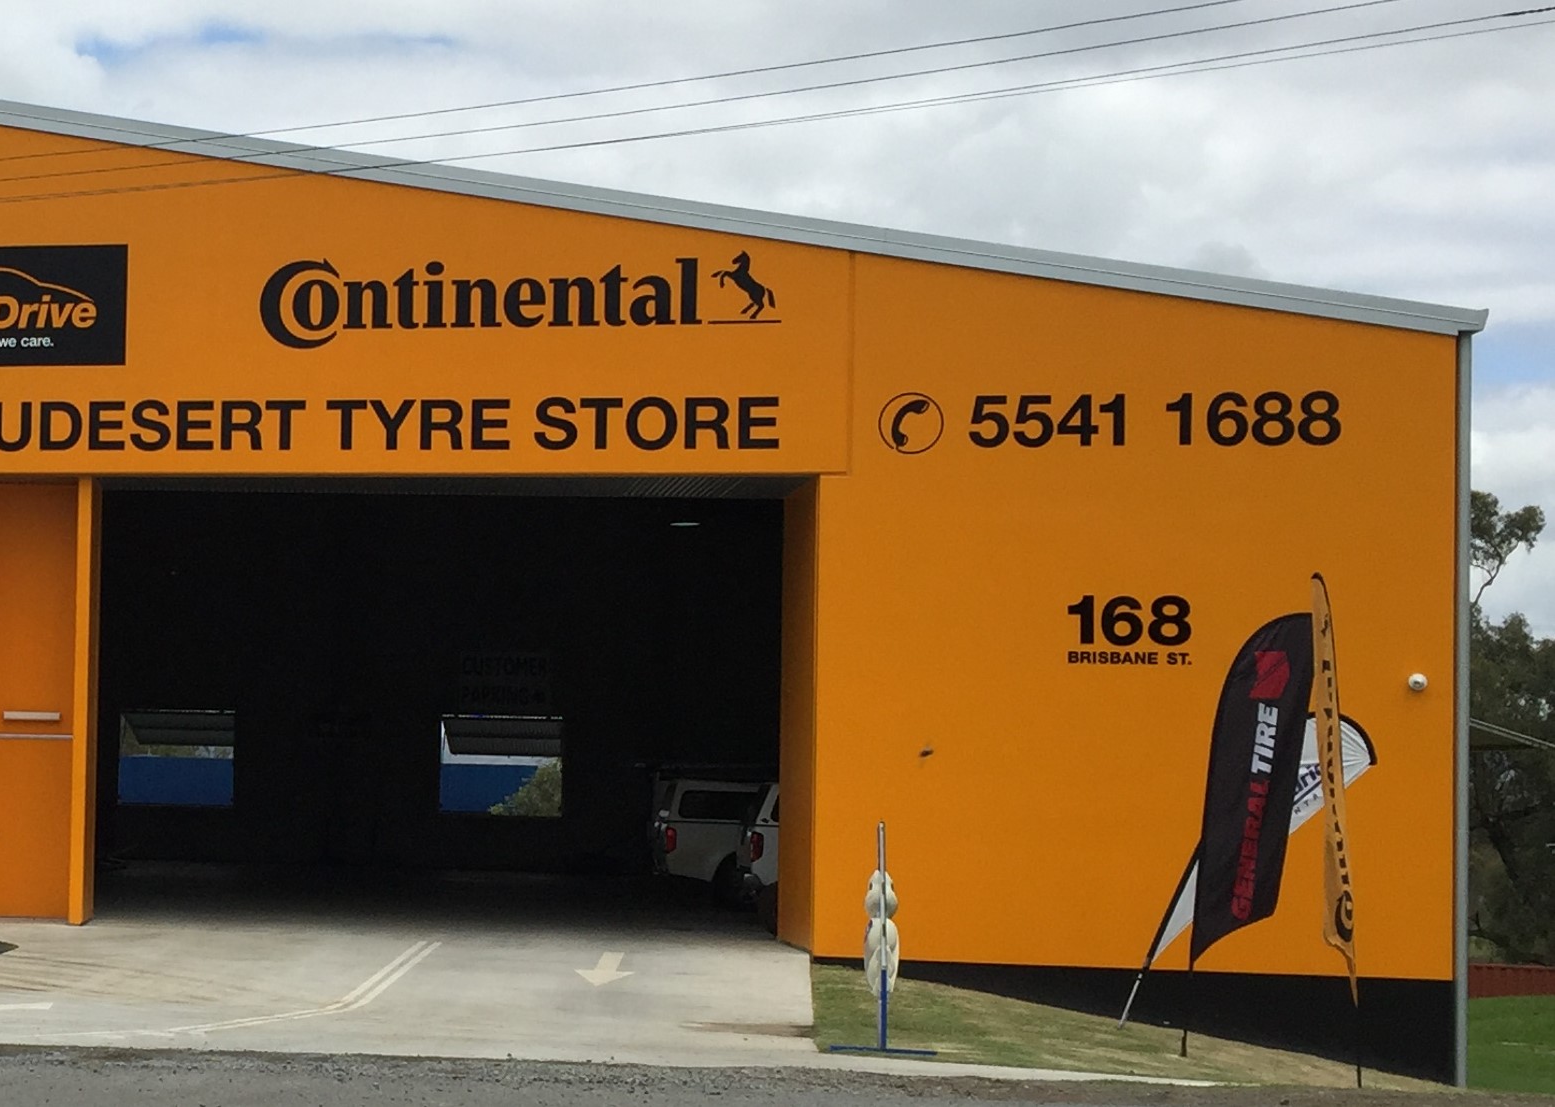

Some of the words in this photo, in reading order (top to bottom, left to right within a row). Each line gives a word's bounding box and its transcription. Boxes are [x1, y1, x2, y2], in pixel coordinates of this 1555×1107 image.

[259, 257, 702, 349] Continental
[21, 336, 54, 348] care.
[326, 399, 511, 451] TYRE
[534, 396, 780, 451] STORE
[968, 394, 1127, 448] 5541
[1165, 390, 1342, 447] 1688
[1067, 594, 1192, 646] 168
[1067, 651, 1159, 665] BRISBANE
[1166, 652, 1193, 666] ST.
[1250, 702, 1279, 775] TIRE
[1231, 778, 1271, 921] GENERAL
